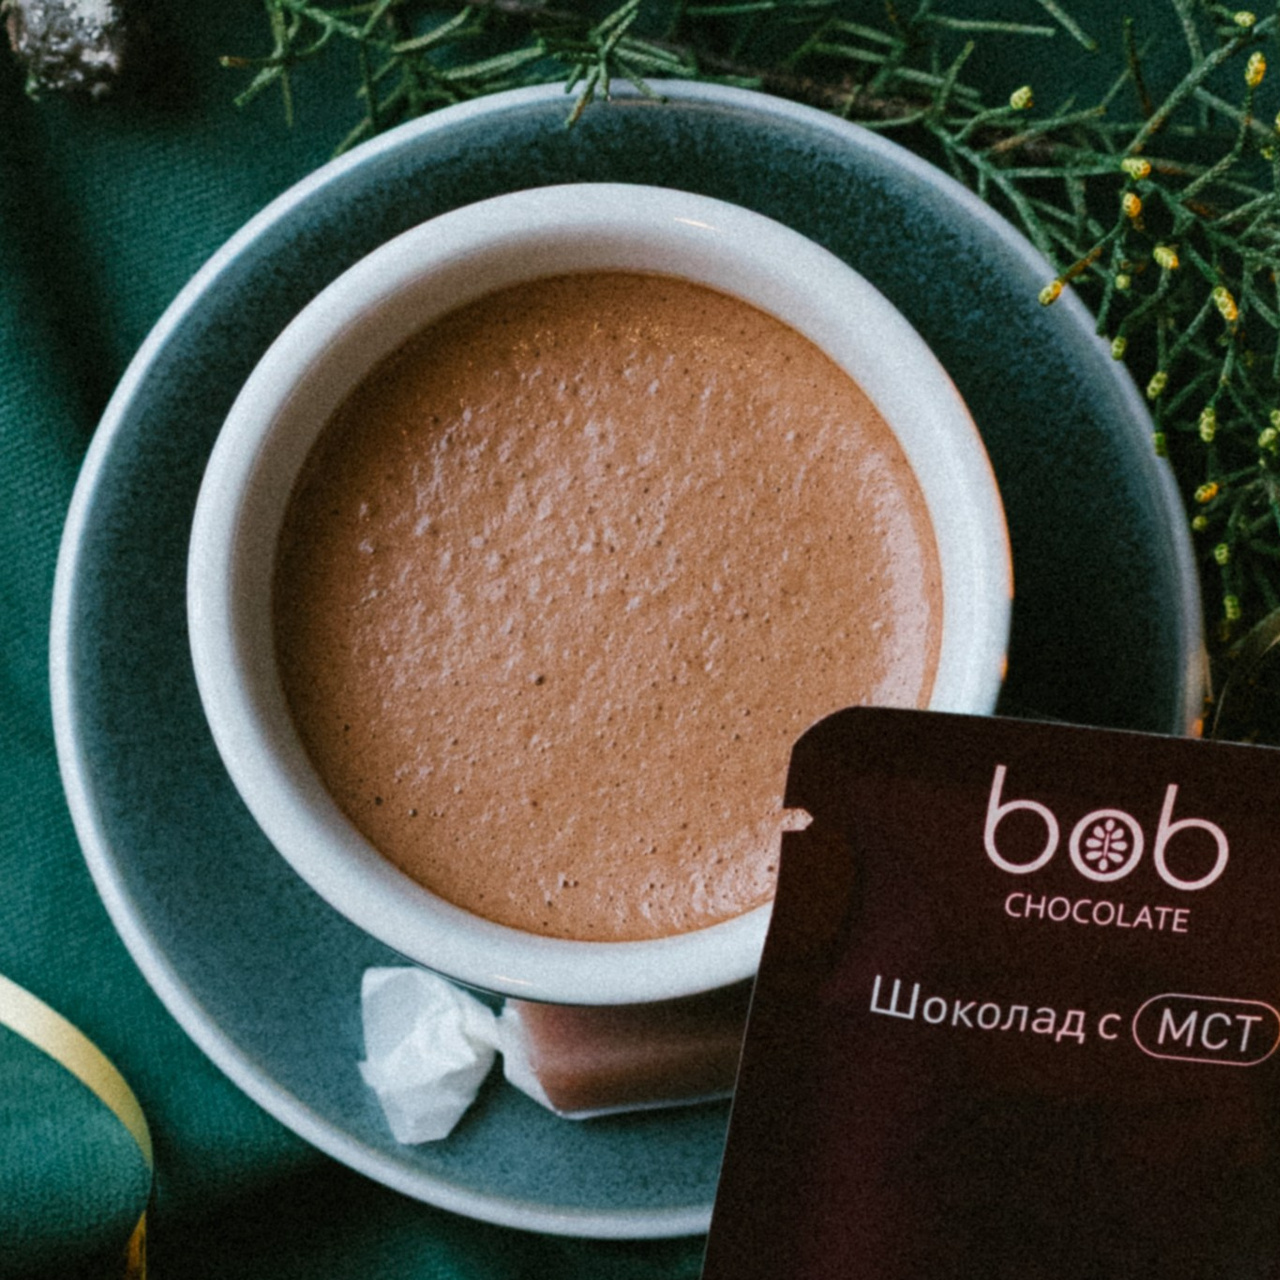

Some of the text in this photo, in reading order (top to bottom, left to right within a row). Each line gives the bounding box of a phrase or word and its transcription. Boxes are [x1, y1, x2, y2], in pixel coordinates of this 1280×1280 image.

[984, 764, 1229, 891] bob
[1005, 892, 1191, 933] CHOCOLATE
[870, 974, 1086, 1045] Шоколад
[1098, 1012, 1121, 1041] с
